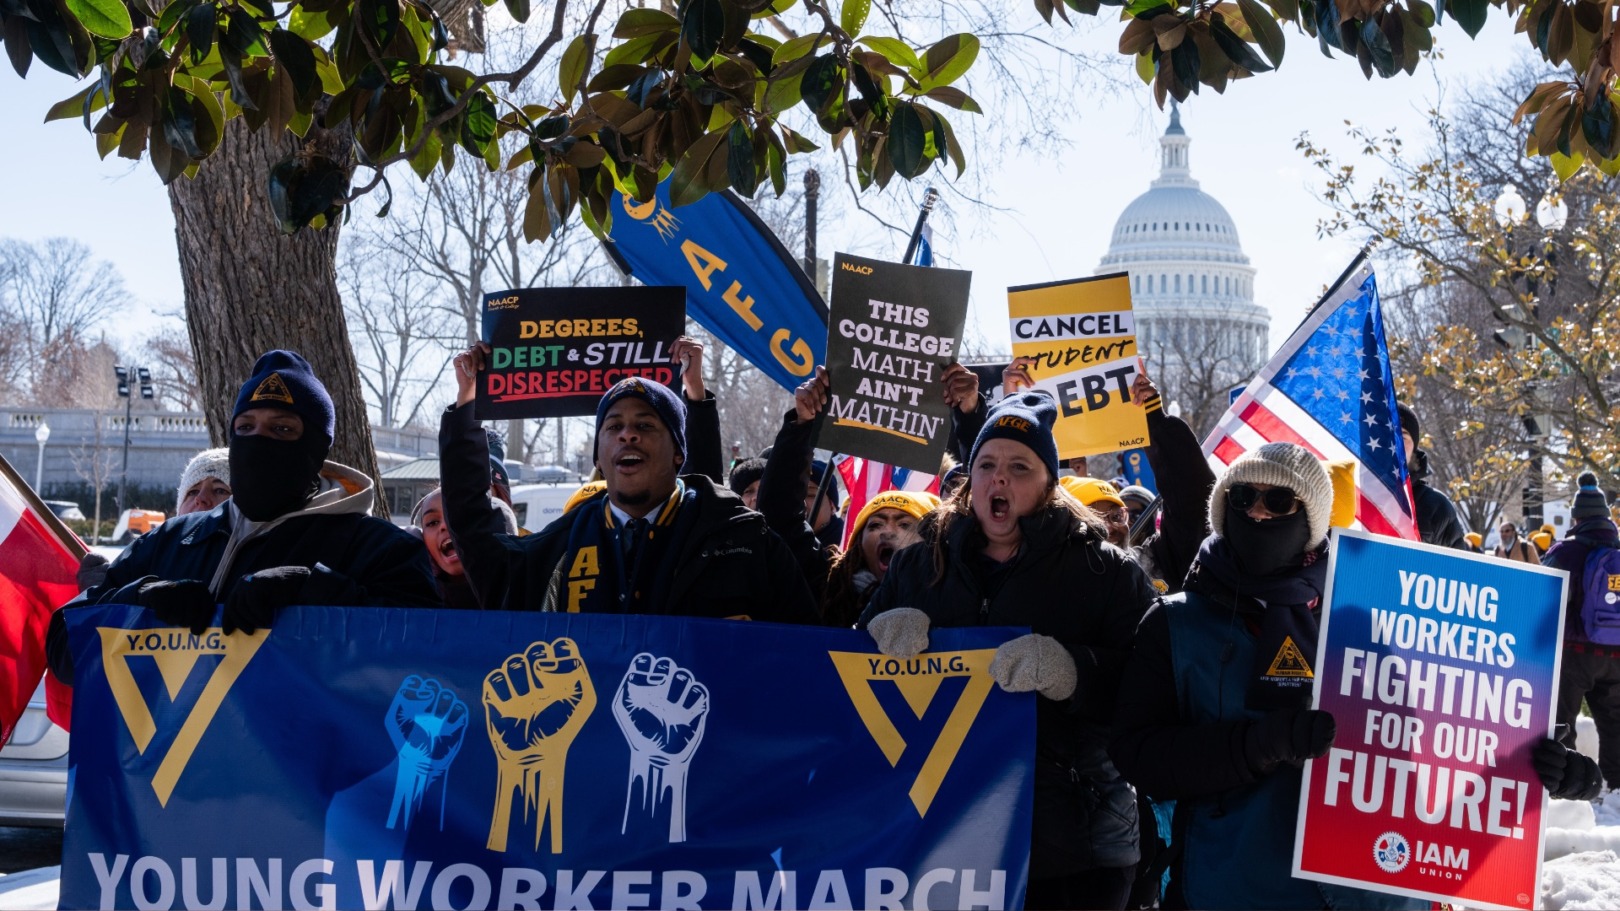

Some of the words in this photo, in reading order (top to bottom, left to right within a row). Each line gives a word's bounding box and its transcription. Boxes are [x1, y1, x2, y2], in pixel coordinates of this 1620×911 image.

[841, 262, 874, 276] NAACP
[488, 296, 519, 307] NAACP
[868, 299, 930, 328] THIS
[519, 318, 644, 339] DEGREES,
[838, 318, 955, 357] COLLEGE
[1015, 314, 1128, 339] CANCEL
[492, 345, 565, 369] DEBT
[567, 348, 580, 362] &
[583, 341, 671, 366] STILL
[851, 347, 935, 383] MATH
[855, 377, 924, 407] AIN'T
[1034, 365, 1136, 418] EBT
[827, 394, 945, 439] MATHIN'
[994, 415, 1031, 433] AFGE
[1119, 437, 1145, 447] NAACP
[873, 496, 910, 506] NAACP
[1398, 569, 1499, 623] YOUNG
[126, 632, 227, 651] Y.O.U.N.G.
[1370, 607, 1516, 669] WORKERS
[867, 656, 970, 676] Y.O.U.N.G.
[1339, 646, 1534, 730] FIGHTING
[1363, 709, 1425, 753] FOR
[1433, 721, 1499, 768] OUR
[1323, 747, 1529, 840] FUTURE!
[1415, 840, 1470, 871] IAM
[87, 852, 337, 910] YOUNG
[356, 858, 708, 910] WORKER
[731, 867, 1007, 910] MARCH
[1419, 867, 1463, 881] UNION
